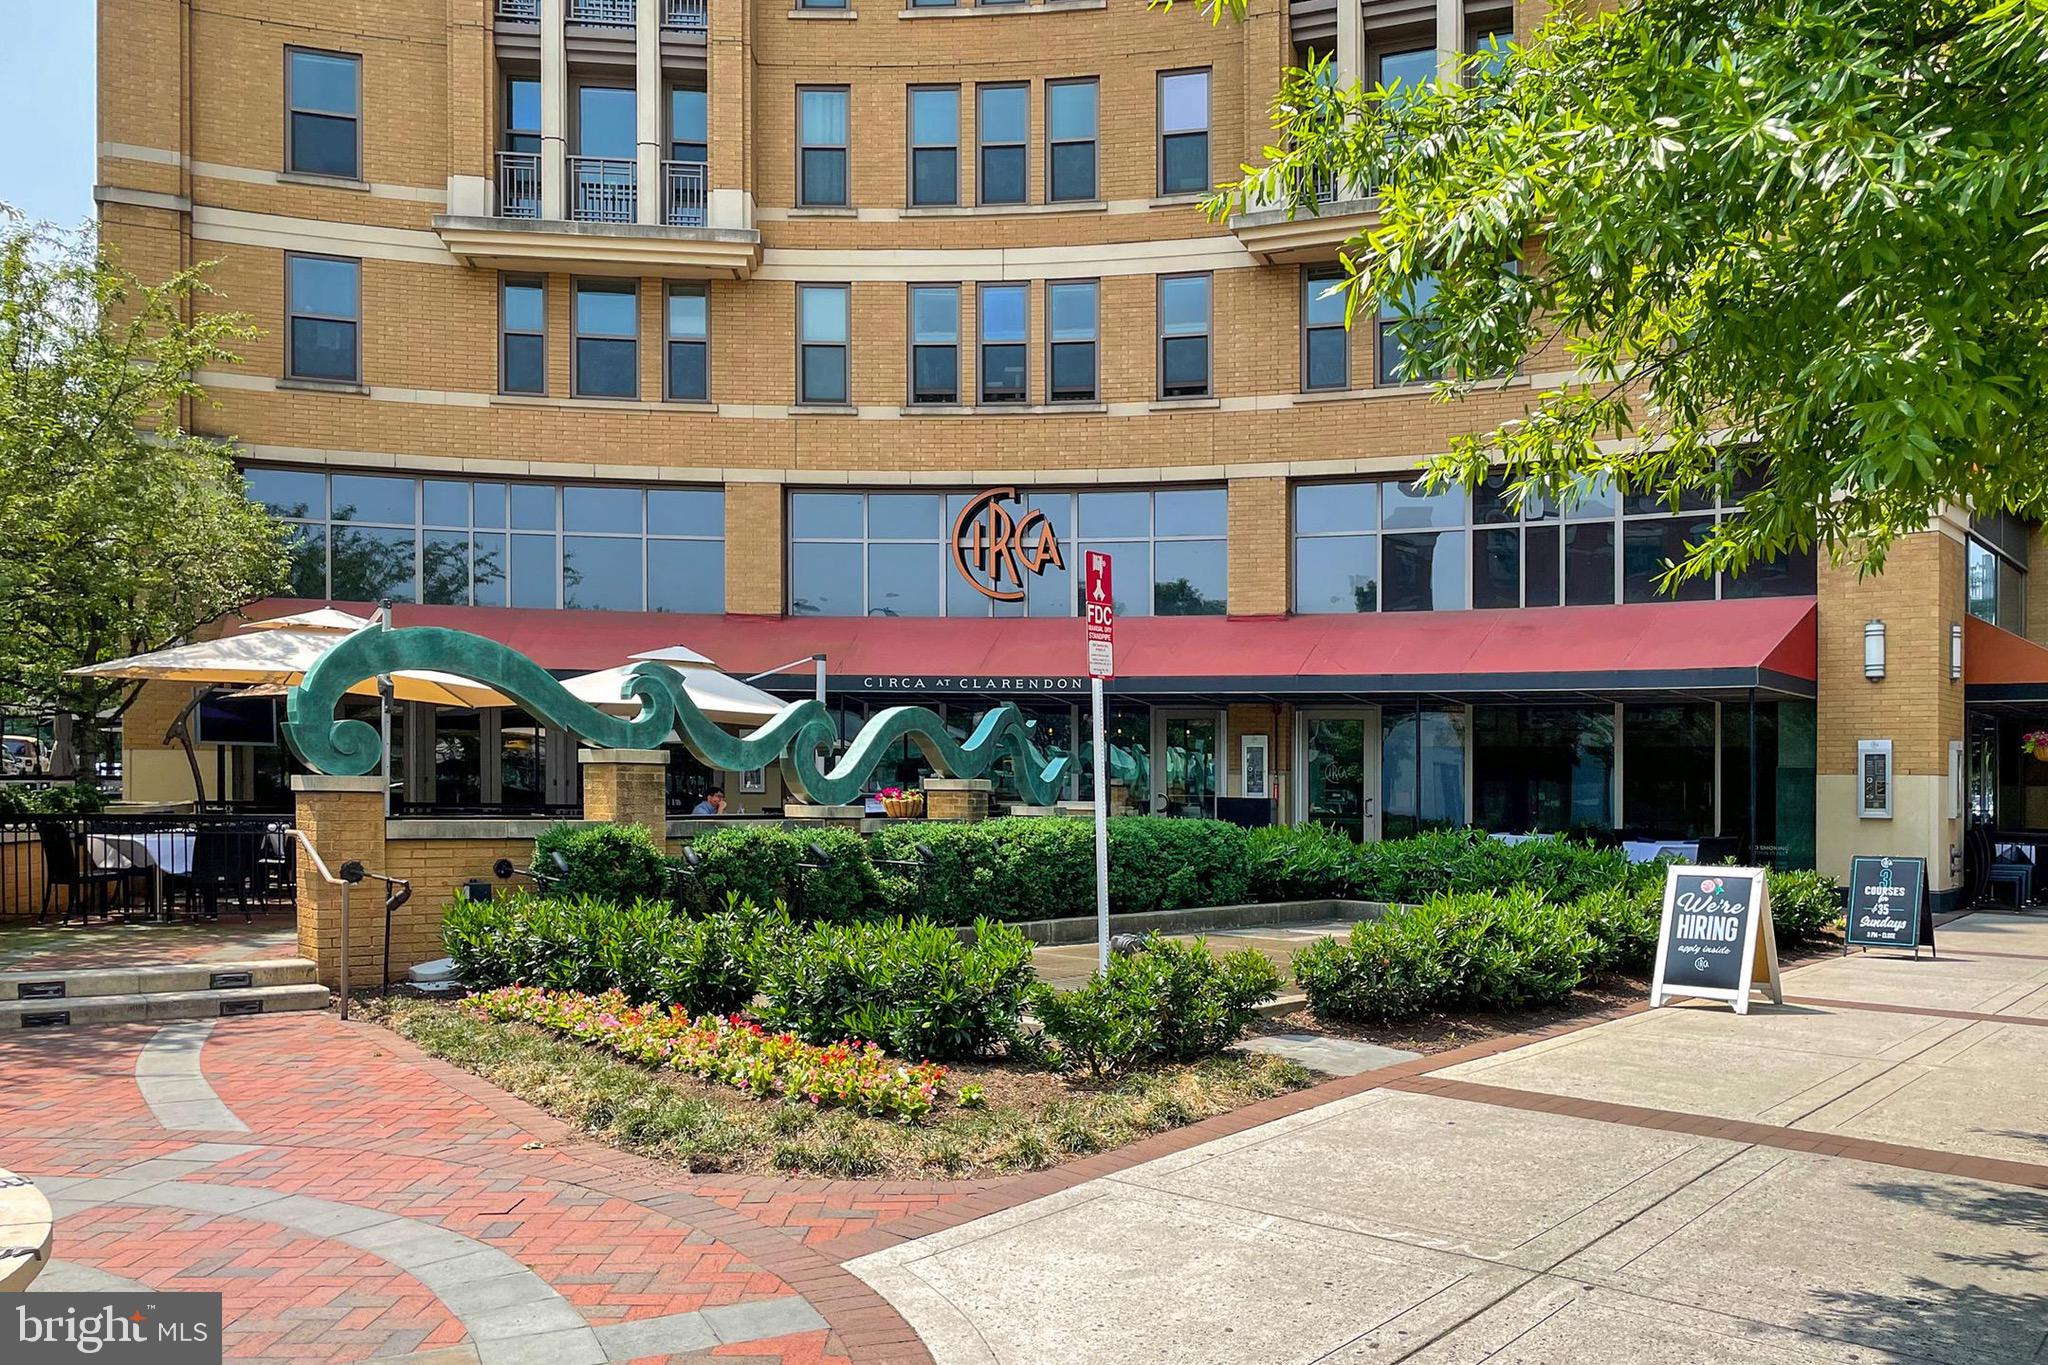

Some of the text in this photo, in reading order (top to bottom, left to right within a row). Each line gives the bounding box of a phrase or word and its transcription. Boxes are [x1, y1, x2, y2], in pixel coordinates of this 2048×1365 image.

[952, 487, 1062, 600] CIRCA
[1088, 604, 1112, 625] FDC
[864, 677, 926, 688] CIRCA
[959, 678, 1083, 689] CLARENDON
[1879, 869, 1892, 888] 3
[1864, 886, 1906, 897] COURSES
[1677, 892, 1745, 914] We're
[1871, 903, 1889, 915] $35
[1676, 914, 1739, 942] HIRING
[1859, 915, 1907, 932] Sundays
[1678, 944, 1731, 955] apply inside
